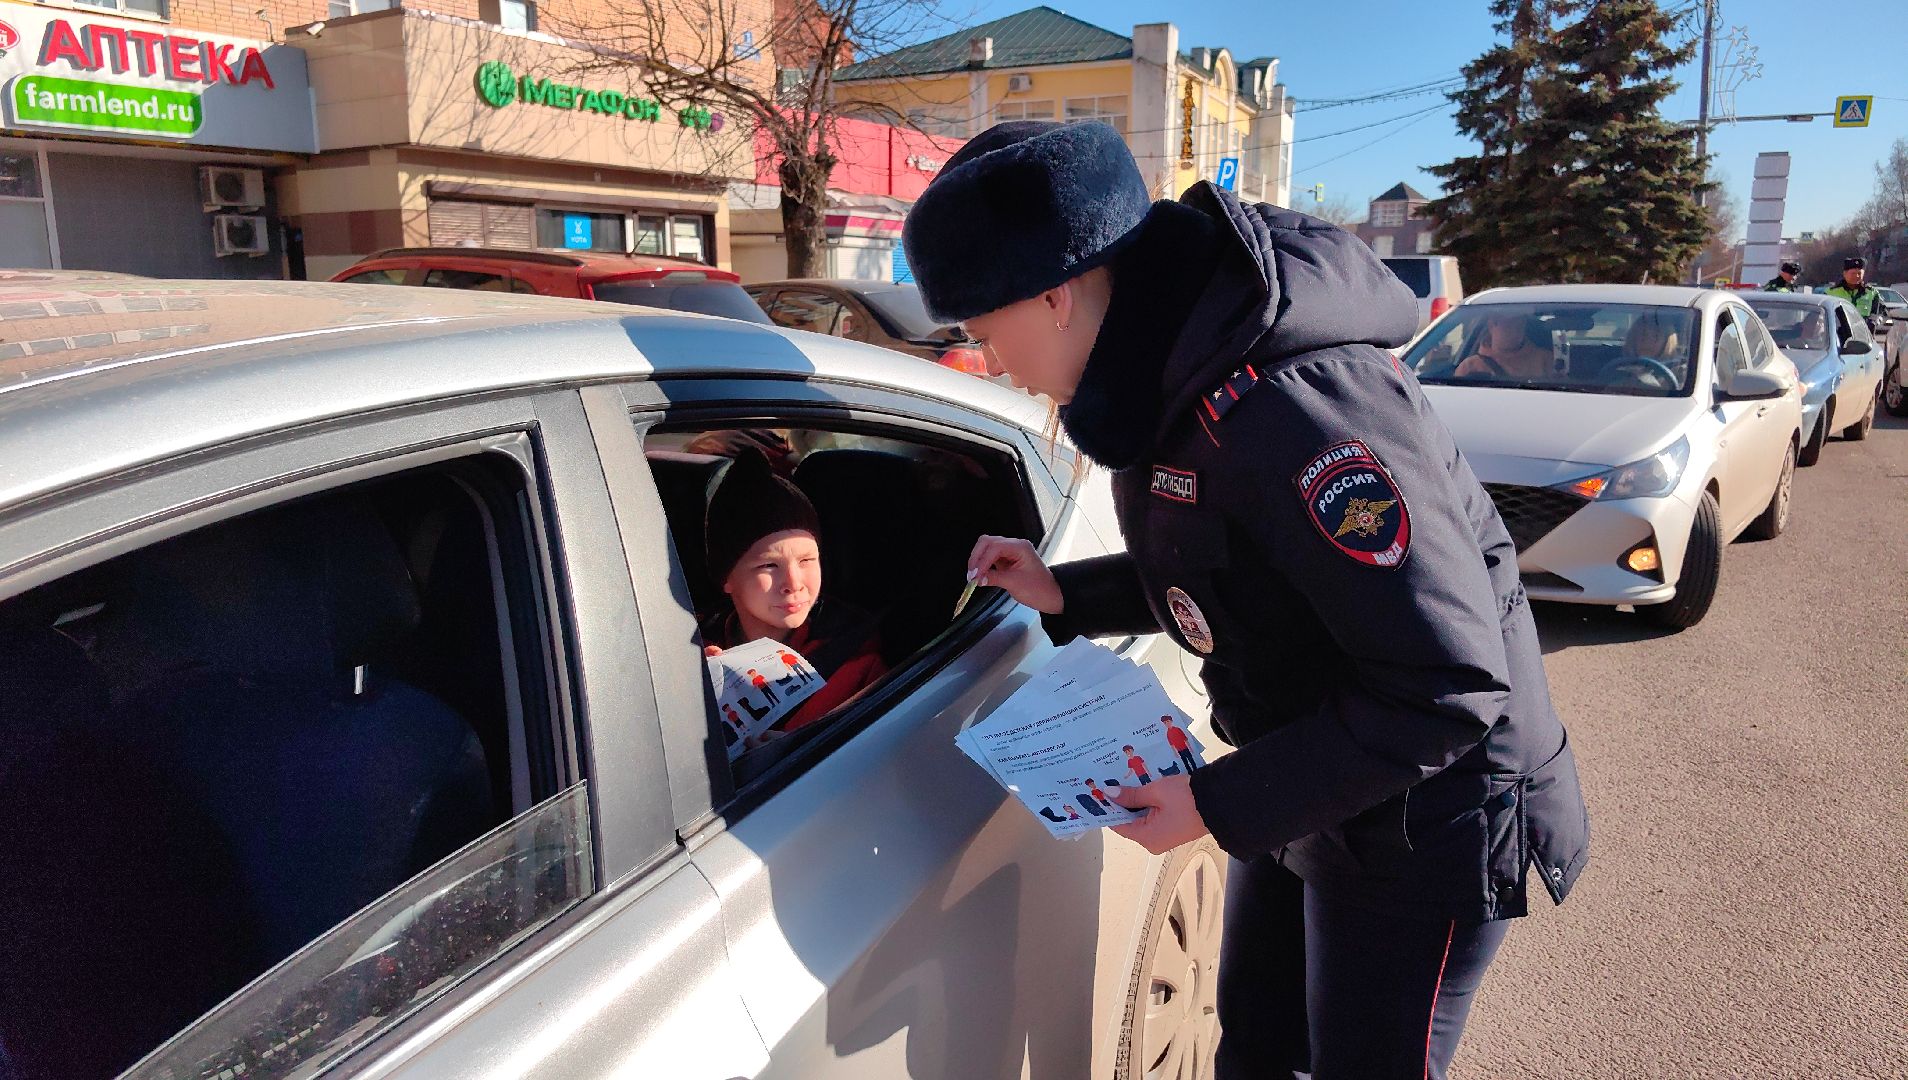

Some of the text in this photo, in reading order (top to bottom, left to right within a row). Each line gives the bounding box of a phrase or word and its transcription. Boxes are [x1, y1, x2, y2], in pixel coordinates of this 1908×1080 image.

[37, 19, 275, 90] АПТЕКА
[25, 83, 195, 122] farmlend.ru
[1301, 446, 1364, 490] ПОЛИЦИЯ
[1318, 473, 1378, 514] РОССИЯ
[1372, 541, 1403, 565] МВД
